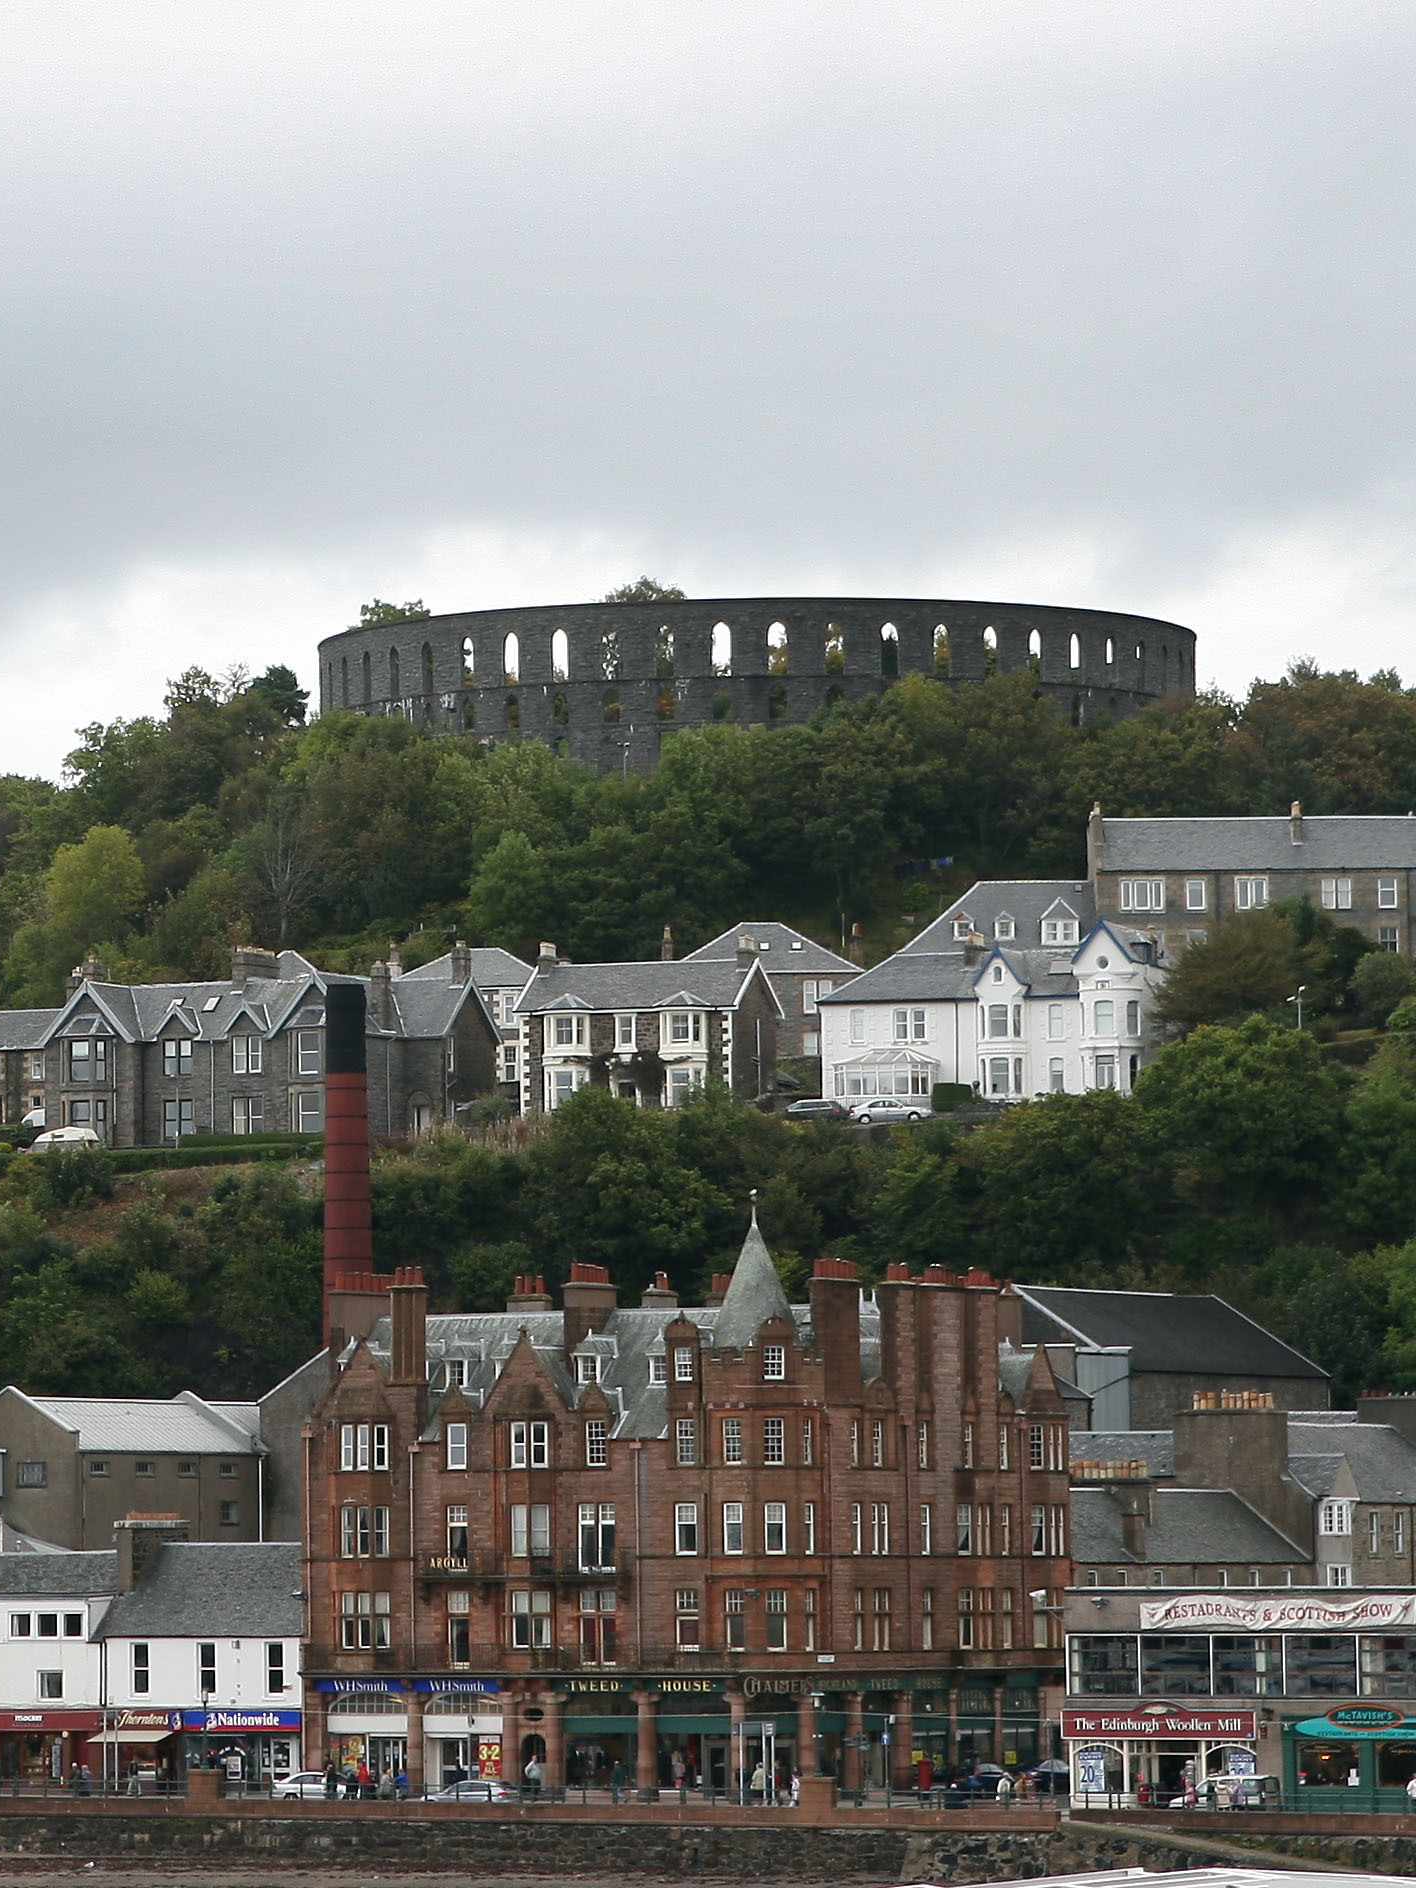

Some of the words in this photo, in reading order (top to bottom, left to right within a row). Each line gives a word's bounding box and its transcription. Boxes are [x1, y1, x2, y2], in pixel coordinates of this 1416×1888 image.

[429, 1557, 469, 1569] ARGYLL
[1164, 1602, 1257, 1623] RESTAURANTS
[1262, 1609, 1274, 1622] &
[1279, 1605, 1346, 1623] SCOTTISH
[1352, 1602, 1393, 1620] SHOW
[333, 1679, 389, 1692] WHSmith
[429, 1679, 485, 1692] WHSmith
[569, 1680, 619, 1692] TWEED
[662, 1680, 711, 1692] HOUSE
[743, 1675, 814, 1698] CHALMERS
[117, 1709, 169, 1727] Thorntons
[217, 1713, 280, 1727] Nationwide
[1074, 1717, 1096, 1731] The
[1101, 1717, 1160, 1734] Edinburgh
[1165, 1717, 1211, 1732] Woollen
[1217, 1718, 1242, 1732] Mill
